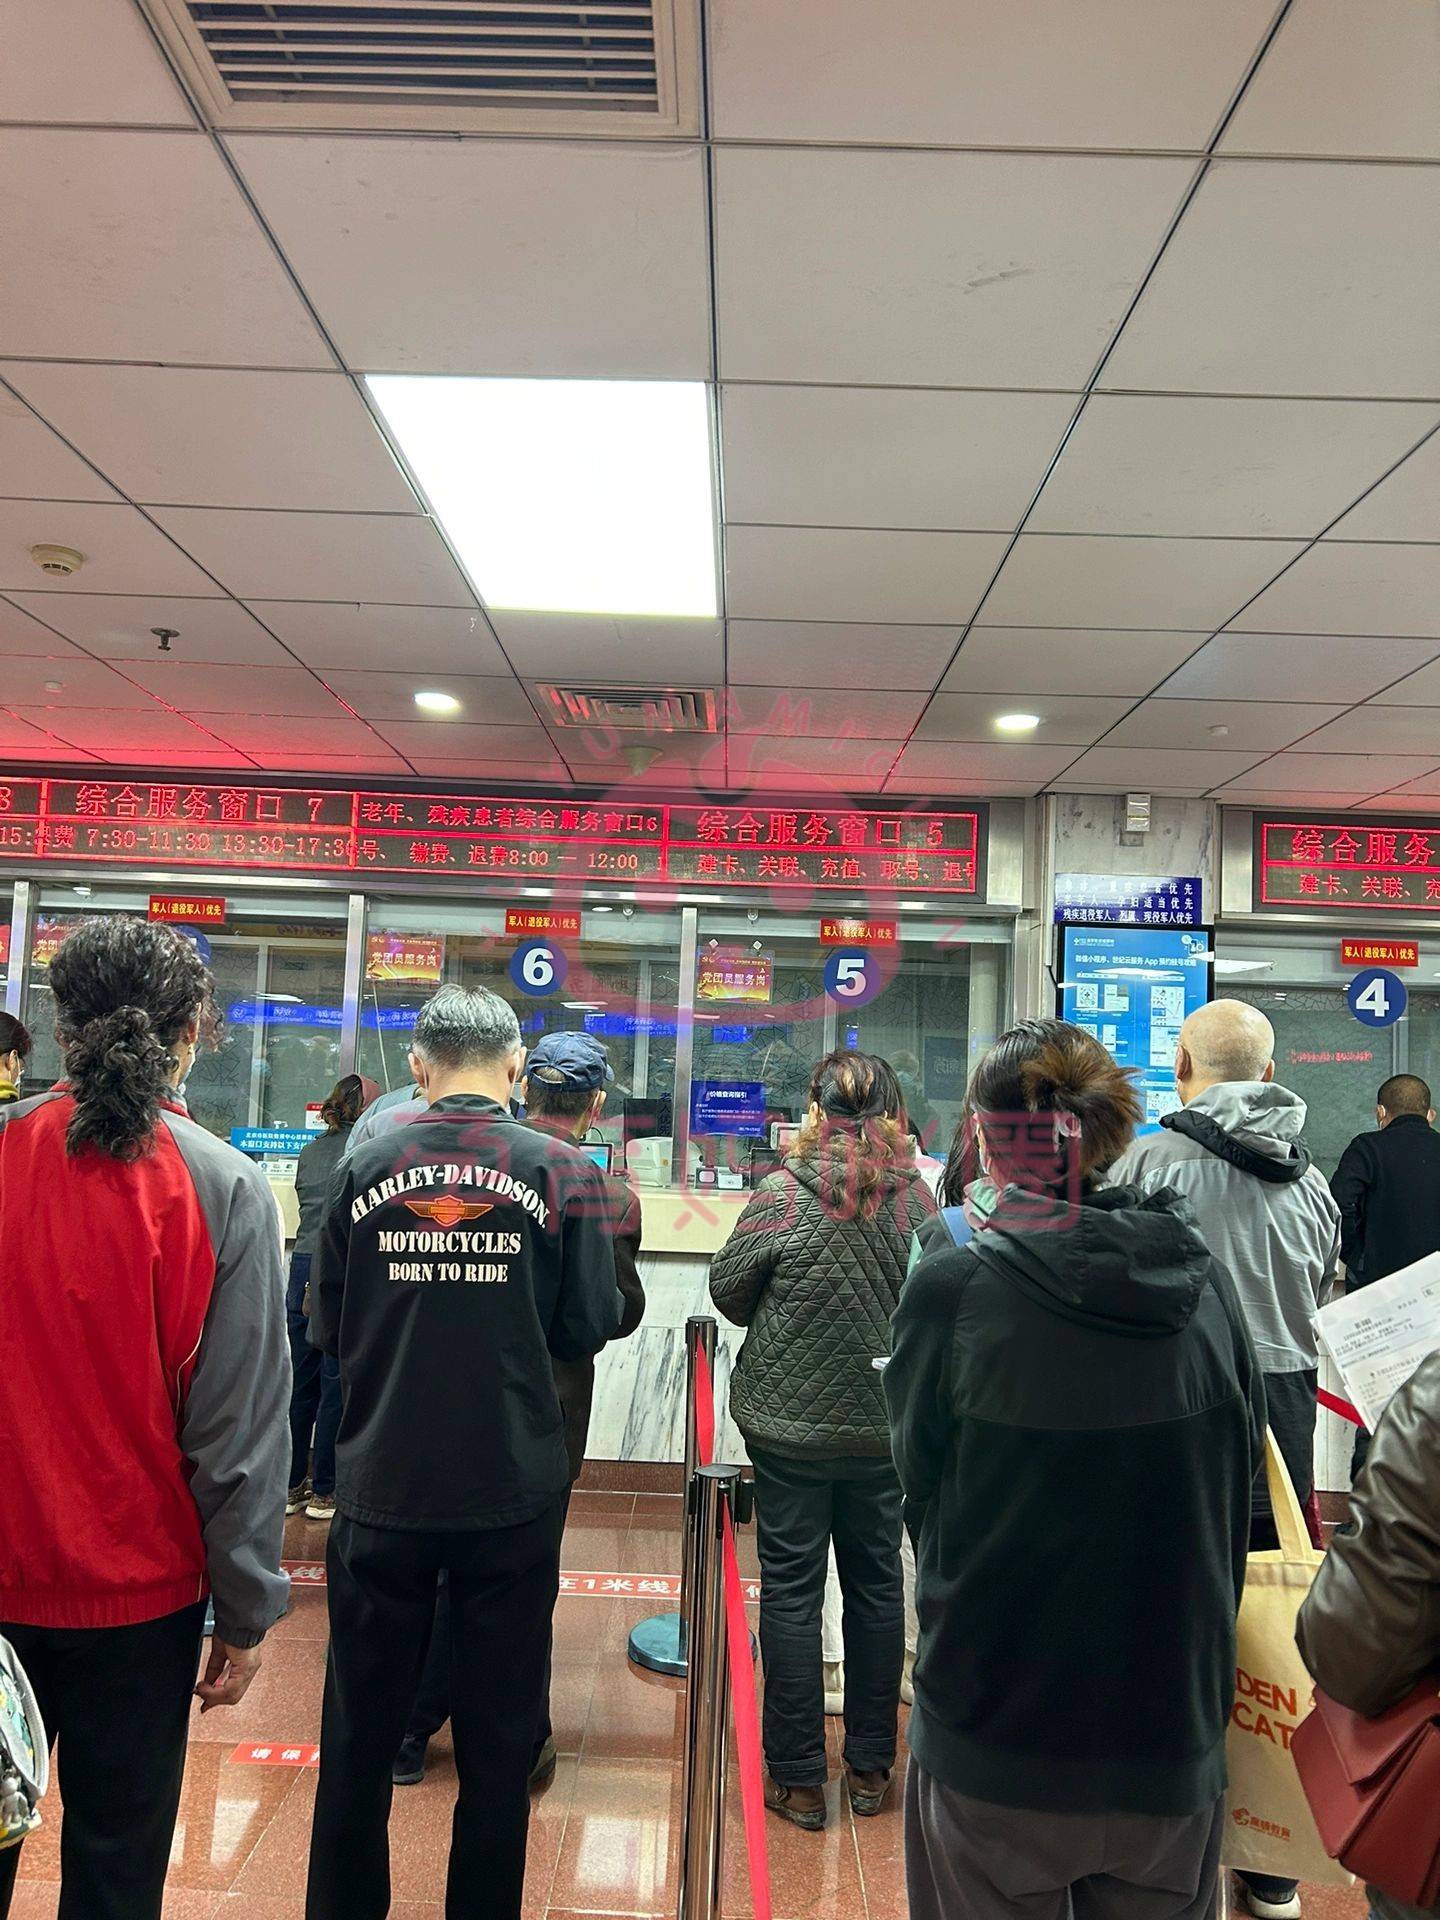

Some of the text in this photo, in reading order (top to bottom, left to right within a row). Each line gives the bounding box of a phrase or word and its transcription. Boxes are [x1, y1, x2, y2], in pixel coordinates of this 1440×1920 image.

[76, 784, 323, 822] 综合服务窗口 7
[362, 802, 658, 832] 老年、残疾患者综合服务窗口6
[697, 811, 943, 846] 综合服务窗口 5
[87, 828, 210, 851] 7:30-11:30
[1292, 830, 1435, 866] 综合服务
[588, 853, 638, 869] 12:00
[152, 902, 221, 916] 军人（退役军人）优先
[508, 915, 578, 929] 军人（退役军人）优先
[372, 952, 437, 967] 党团员服务岗
[1144, 958, 1158, 967] App
[1344, 946, 1415, 960] 军人（退役军人）优先
[523, 948, 554, 986] 6
[702, 971, 766, 986] 党团员服务岗
[836, 959, 866, 997] 5
[1356, 978, 1390, 1018] 4
[378, 1231, 522, 1254] MOTORCYCLES
[388, 1263, 508, 1282] BORN TO RIDE
[1236, 1667, 1297, 1716] DEN
[1232, 1702, 1296, 1750] CAT
